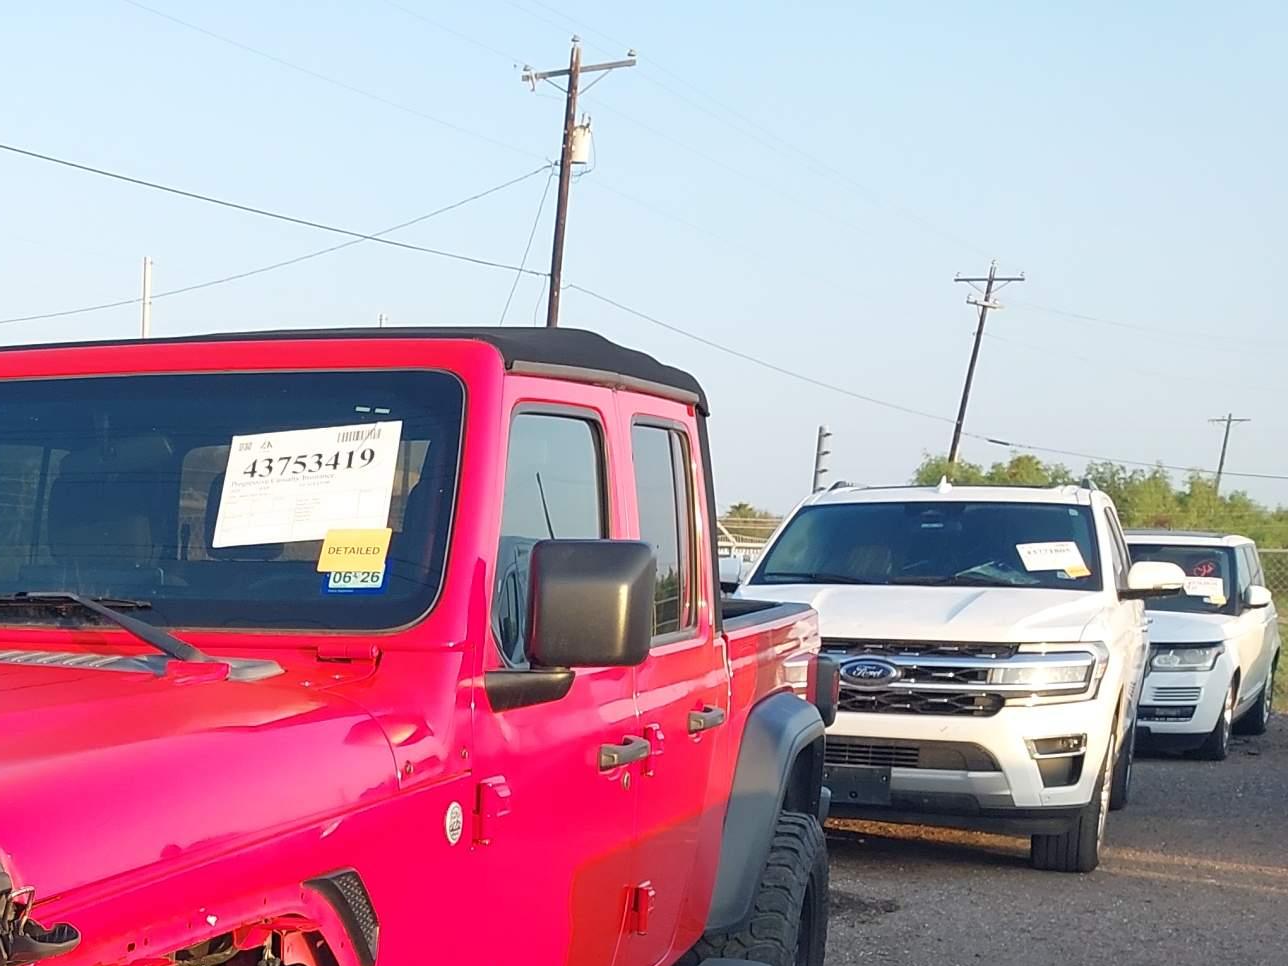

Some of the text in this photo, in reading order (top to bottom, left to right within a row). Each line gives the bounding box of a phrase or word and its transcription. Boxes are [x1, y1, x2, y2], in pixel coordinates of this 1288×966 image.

[243, 447, 376, 478] 43753419
[327, 546, 381, 555] DETAILED
[332, 571, 381, 584] 06 26
[852, 664, 884, 679] Ford
